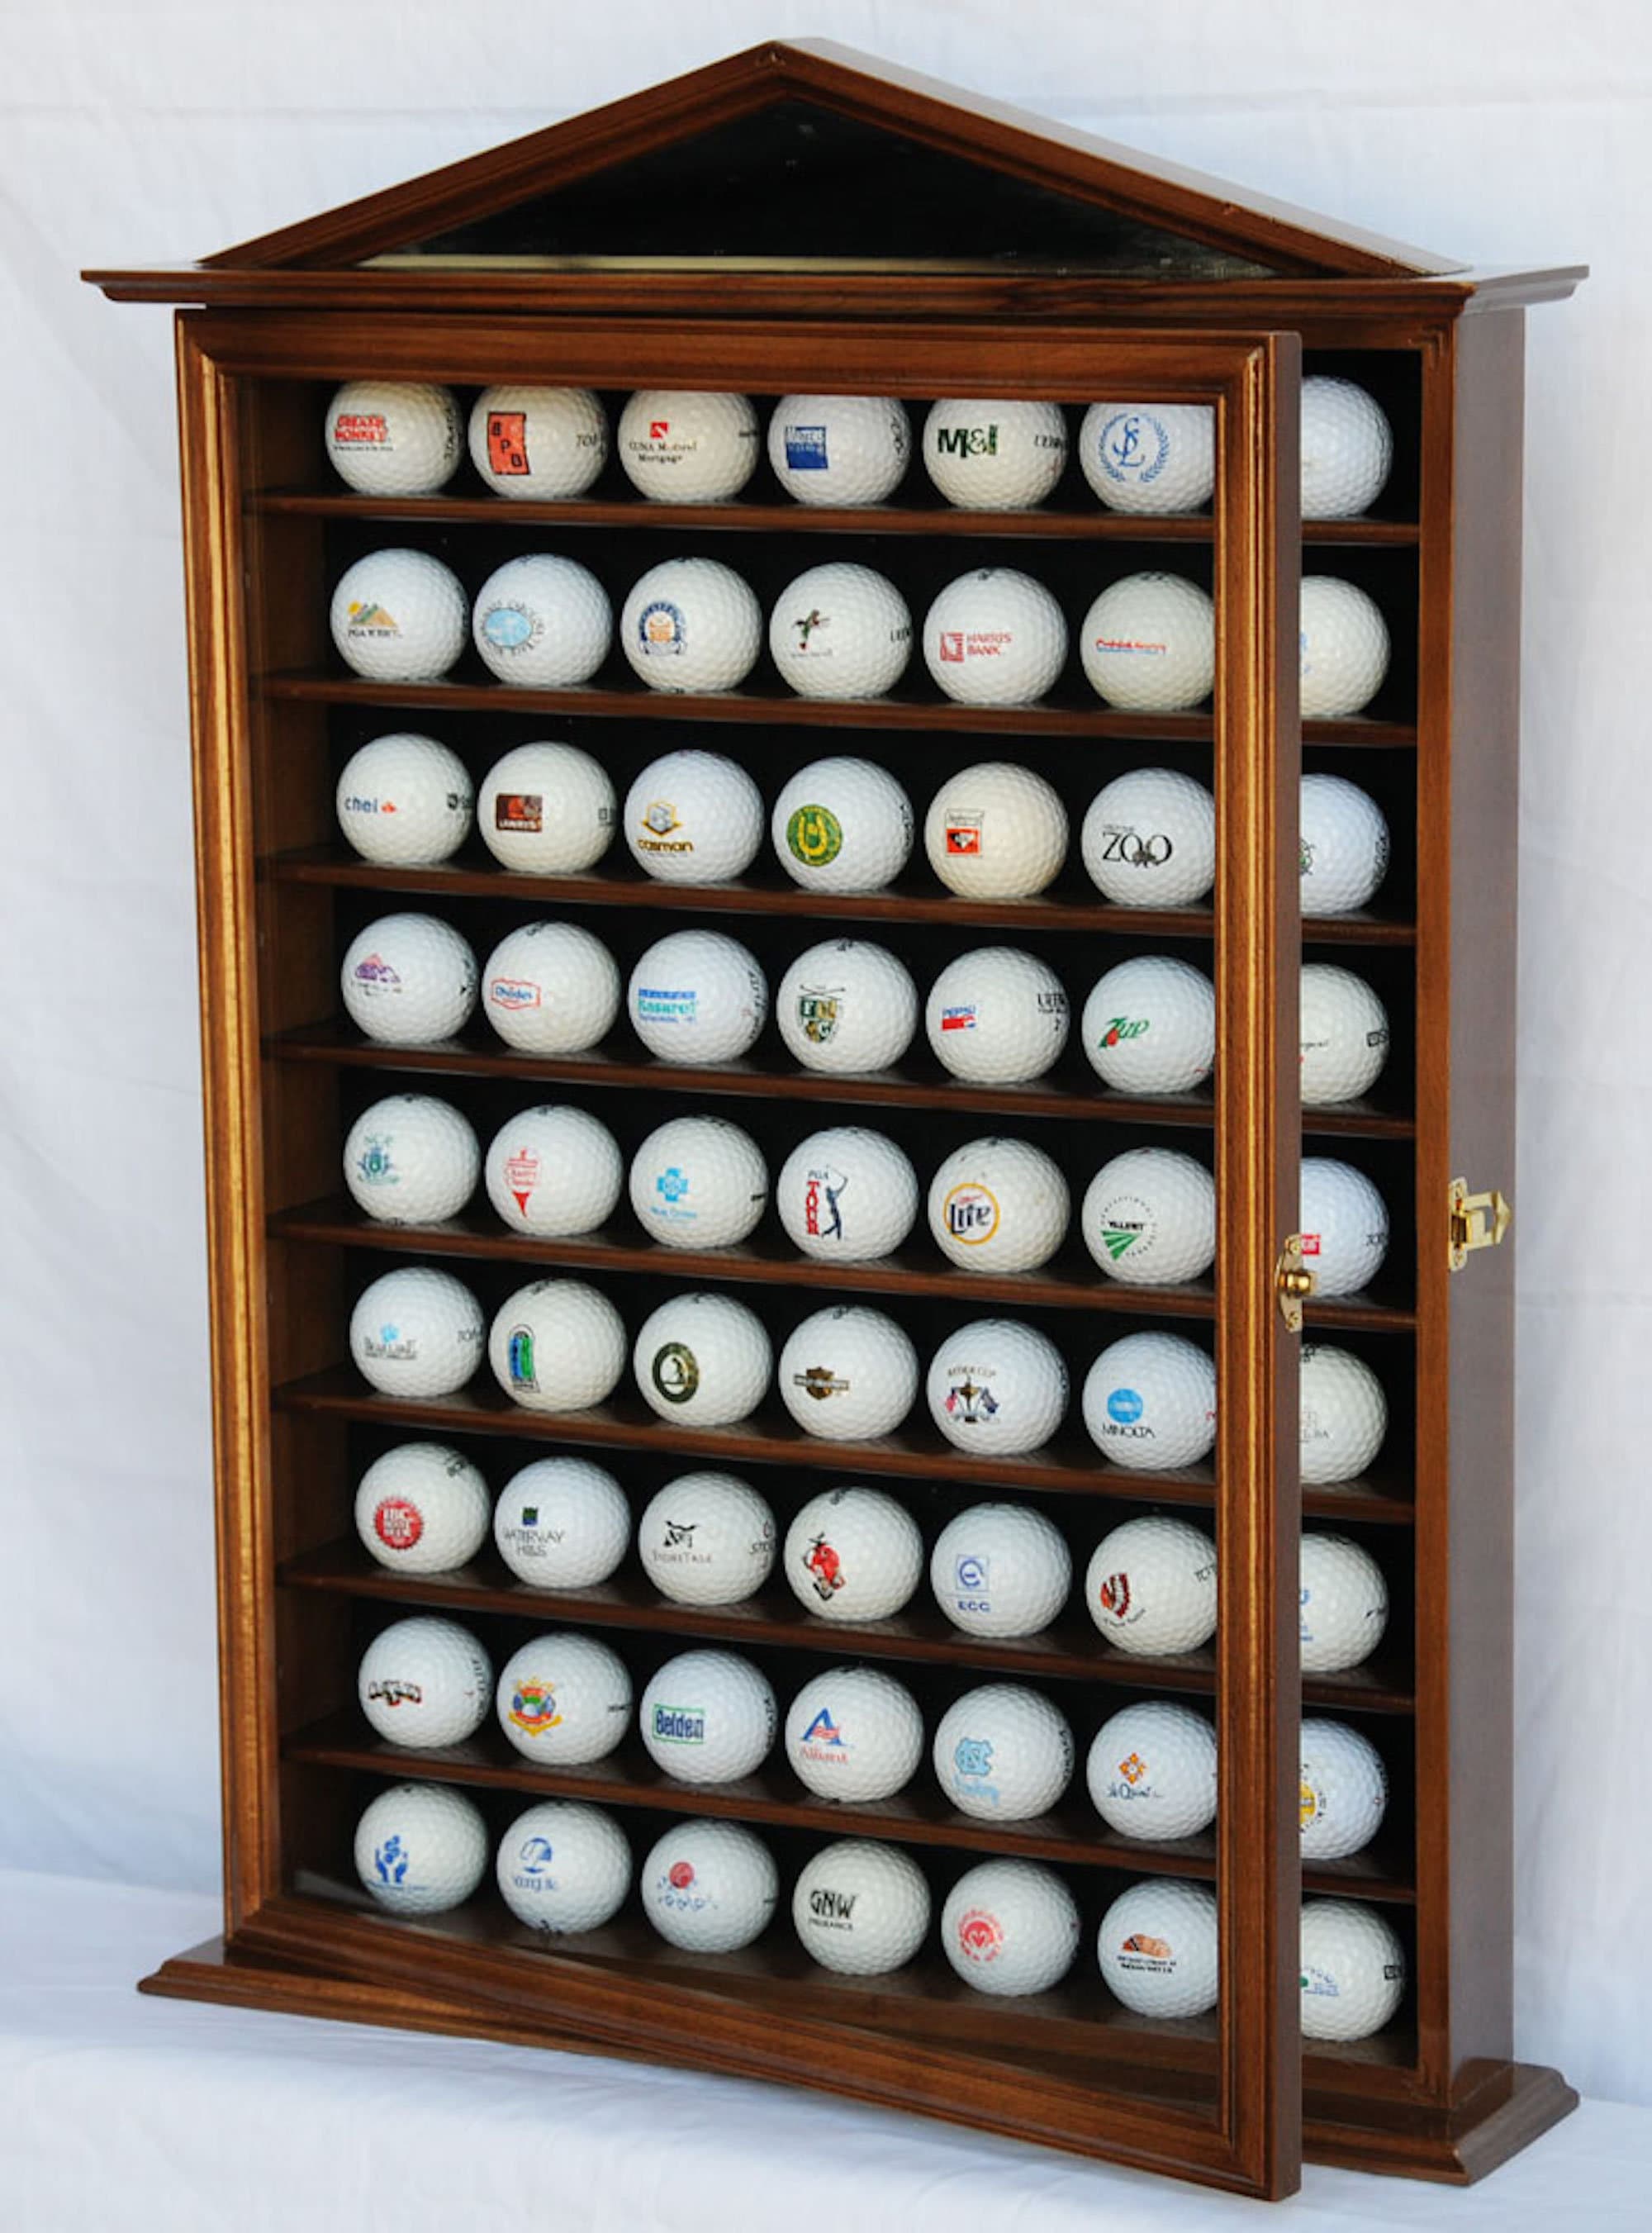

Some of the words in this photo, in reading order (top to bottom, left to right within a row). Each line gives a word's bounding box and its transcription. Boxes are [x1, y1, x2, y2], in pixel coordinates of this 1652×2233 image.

[938, 425, 999, 459] M&I
[1103, 831, 1173, 867] ZOO
[951, 1203, 990, 1234] Lite
[1102, 1423, 1155, 1438] MINOLTA
[656, 1709, 704, 1739] Belden
[809, 1889, 859, 1919] GNW
